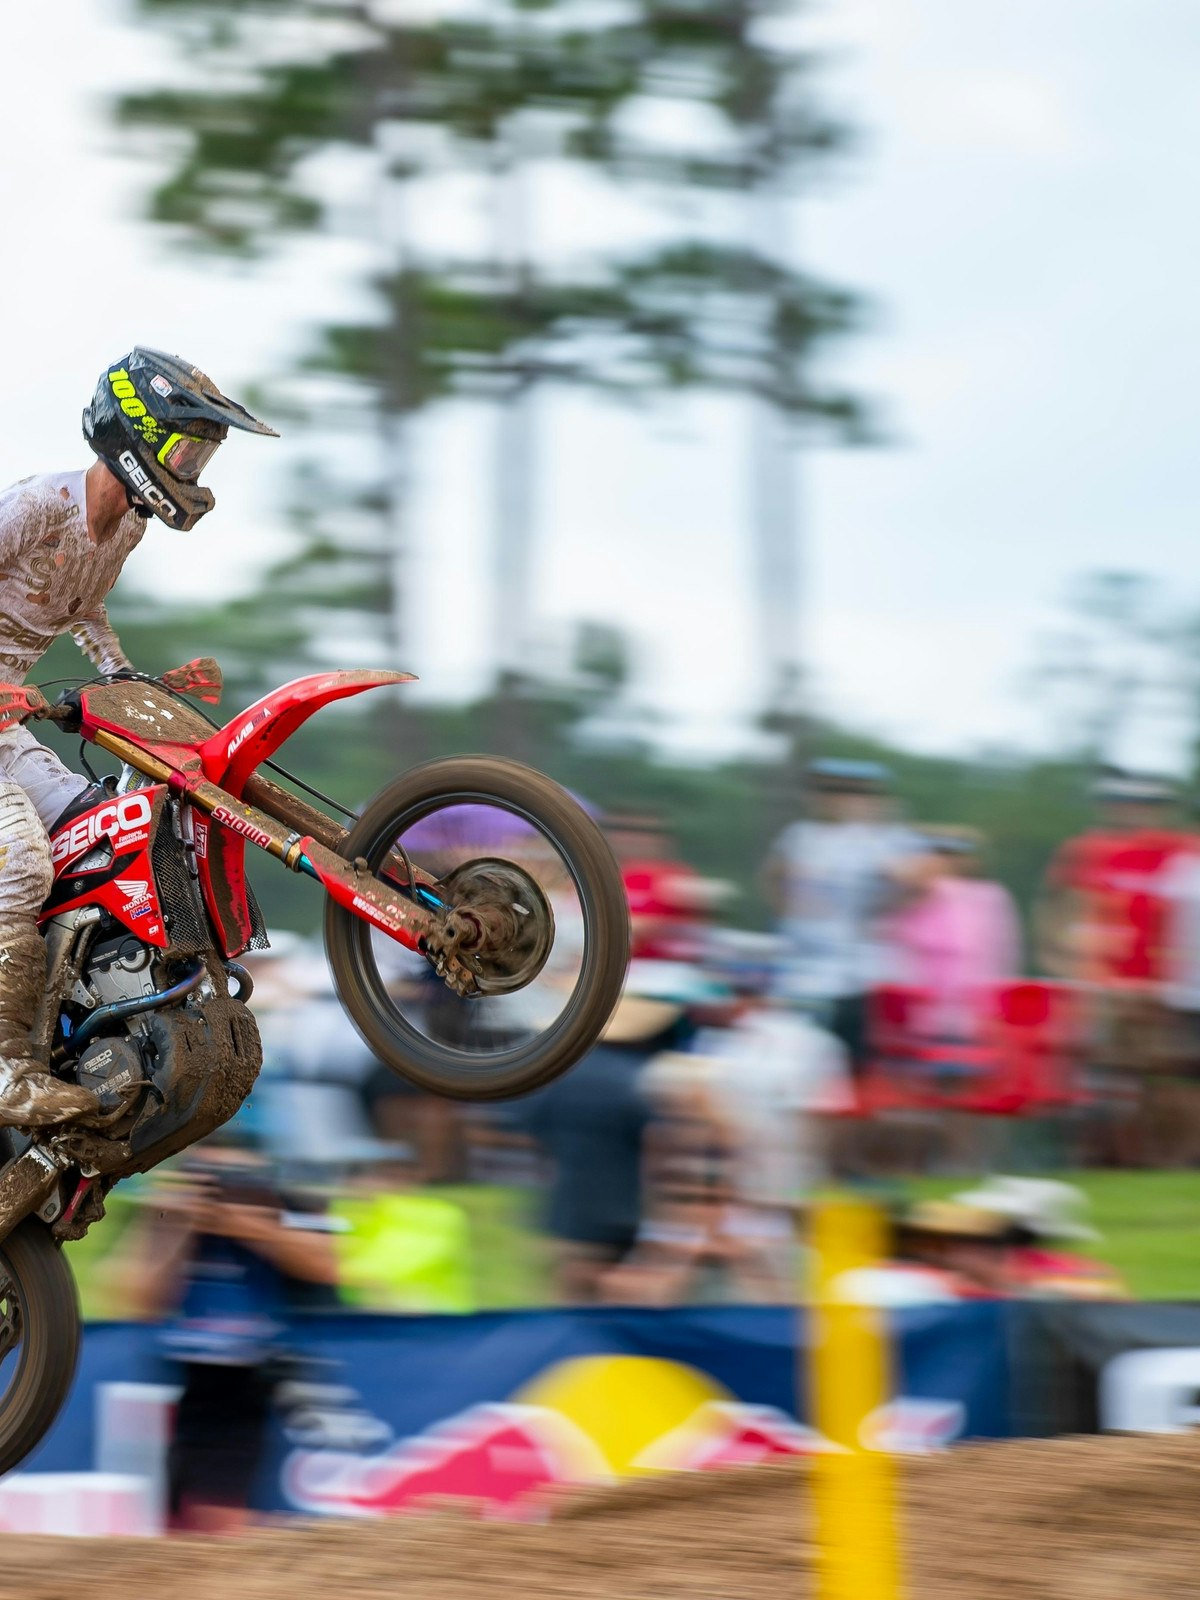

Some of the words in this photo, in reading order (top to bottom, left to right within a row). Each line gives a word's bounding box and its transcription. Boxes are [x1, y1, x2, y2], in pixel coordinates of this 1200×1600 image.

[118, 450, 177, 518] GEICO
[51, 795, 152, 863] GEICO
[211, 805, 272, 850] SHOWA
[122, 893, 153, 912] HONDA
[84, 1048, 113, 1070] GEICO
[89, 1057, 113, 1073] HONDA
